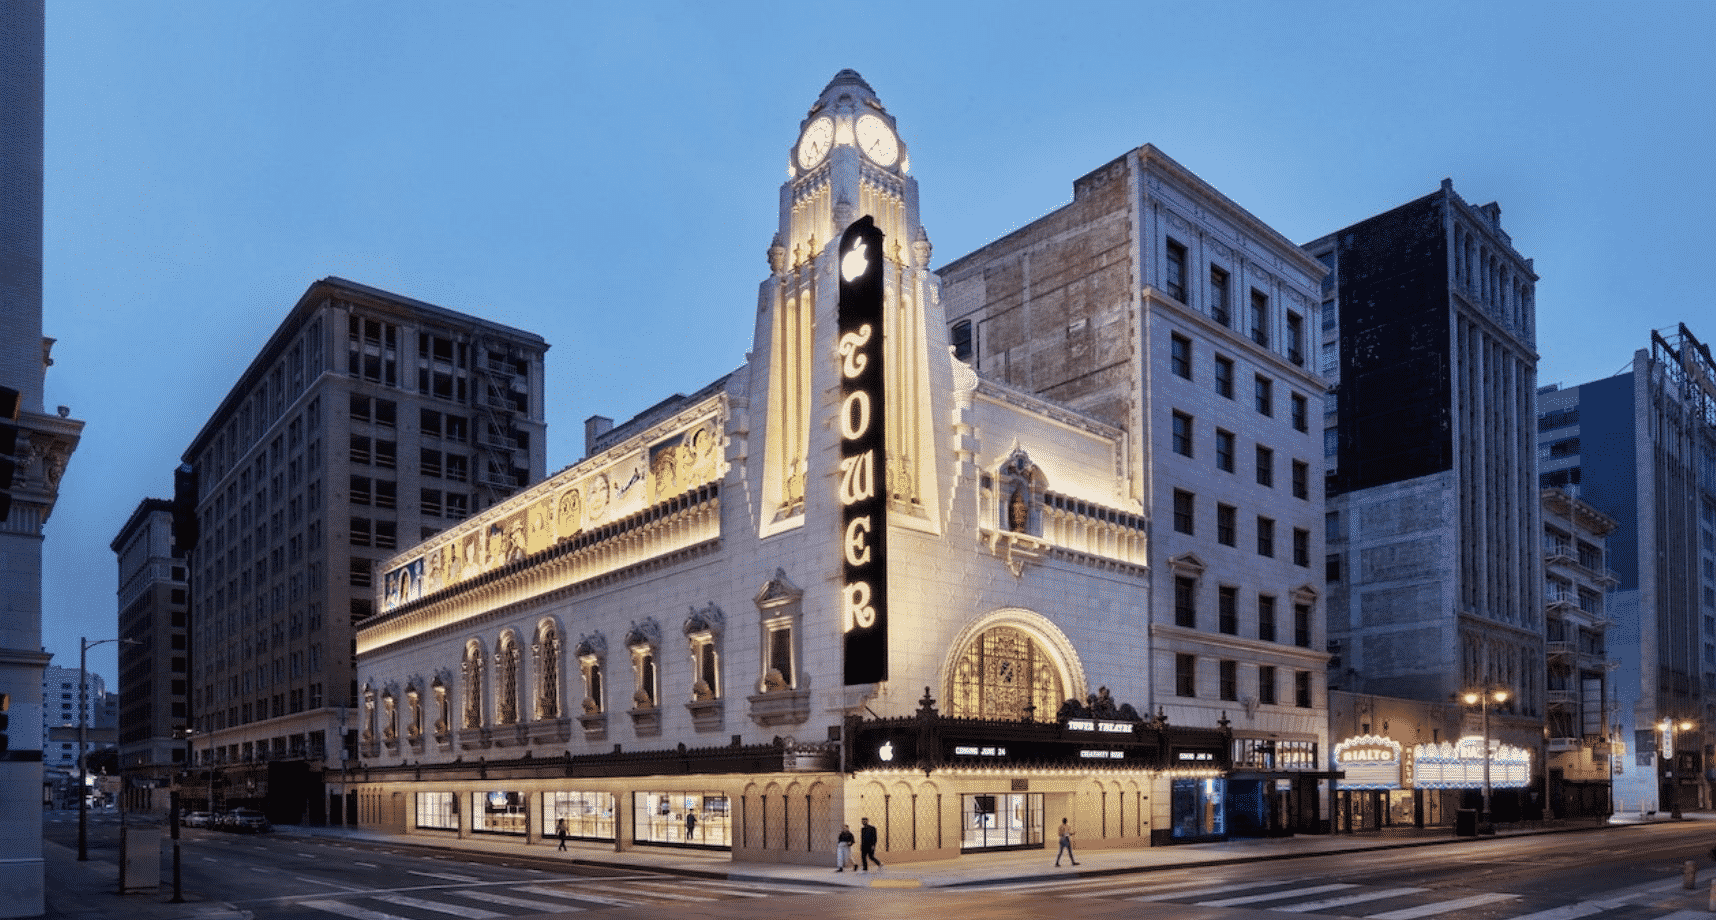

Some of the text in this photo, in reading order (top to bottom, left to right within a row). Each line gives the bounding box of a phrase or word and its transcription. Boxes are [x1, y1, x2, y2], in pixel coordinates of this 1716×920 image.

[839, 324, 875, 633] TOWER
[1068, 720, 1132, 733] TOWER THEATRE
[1343, 749, 1391, 760] RIALTO
